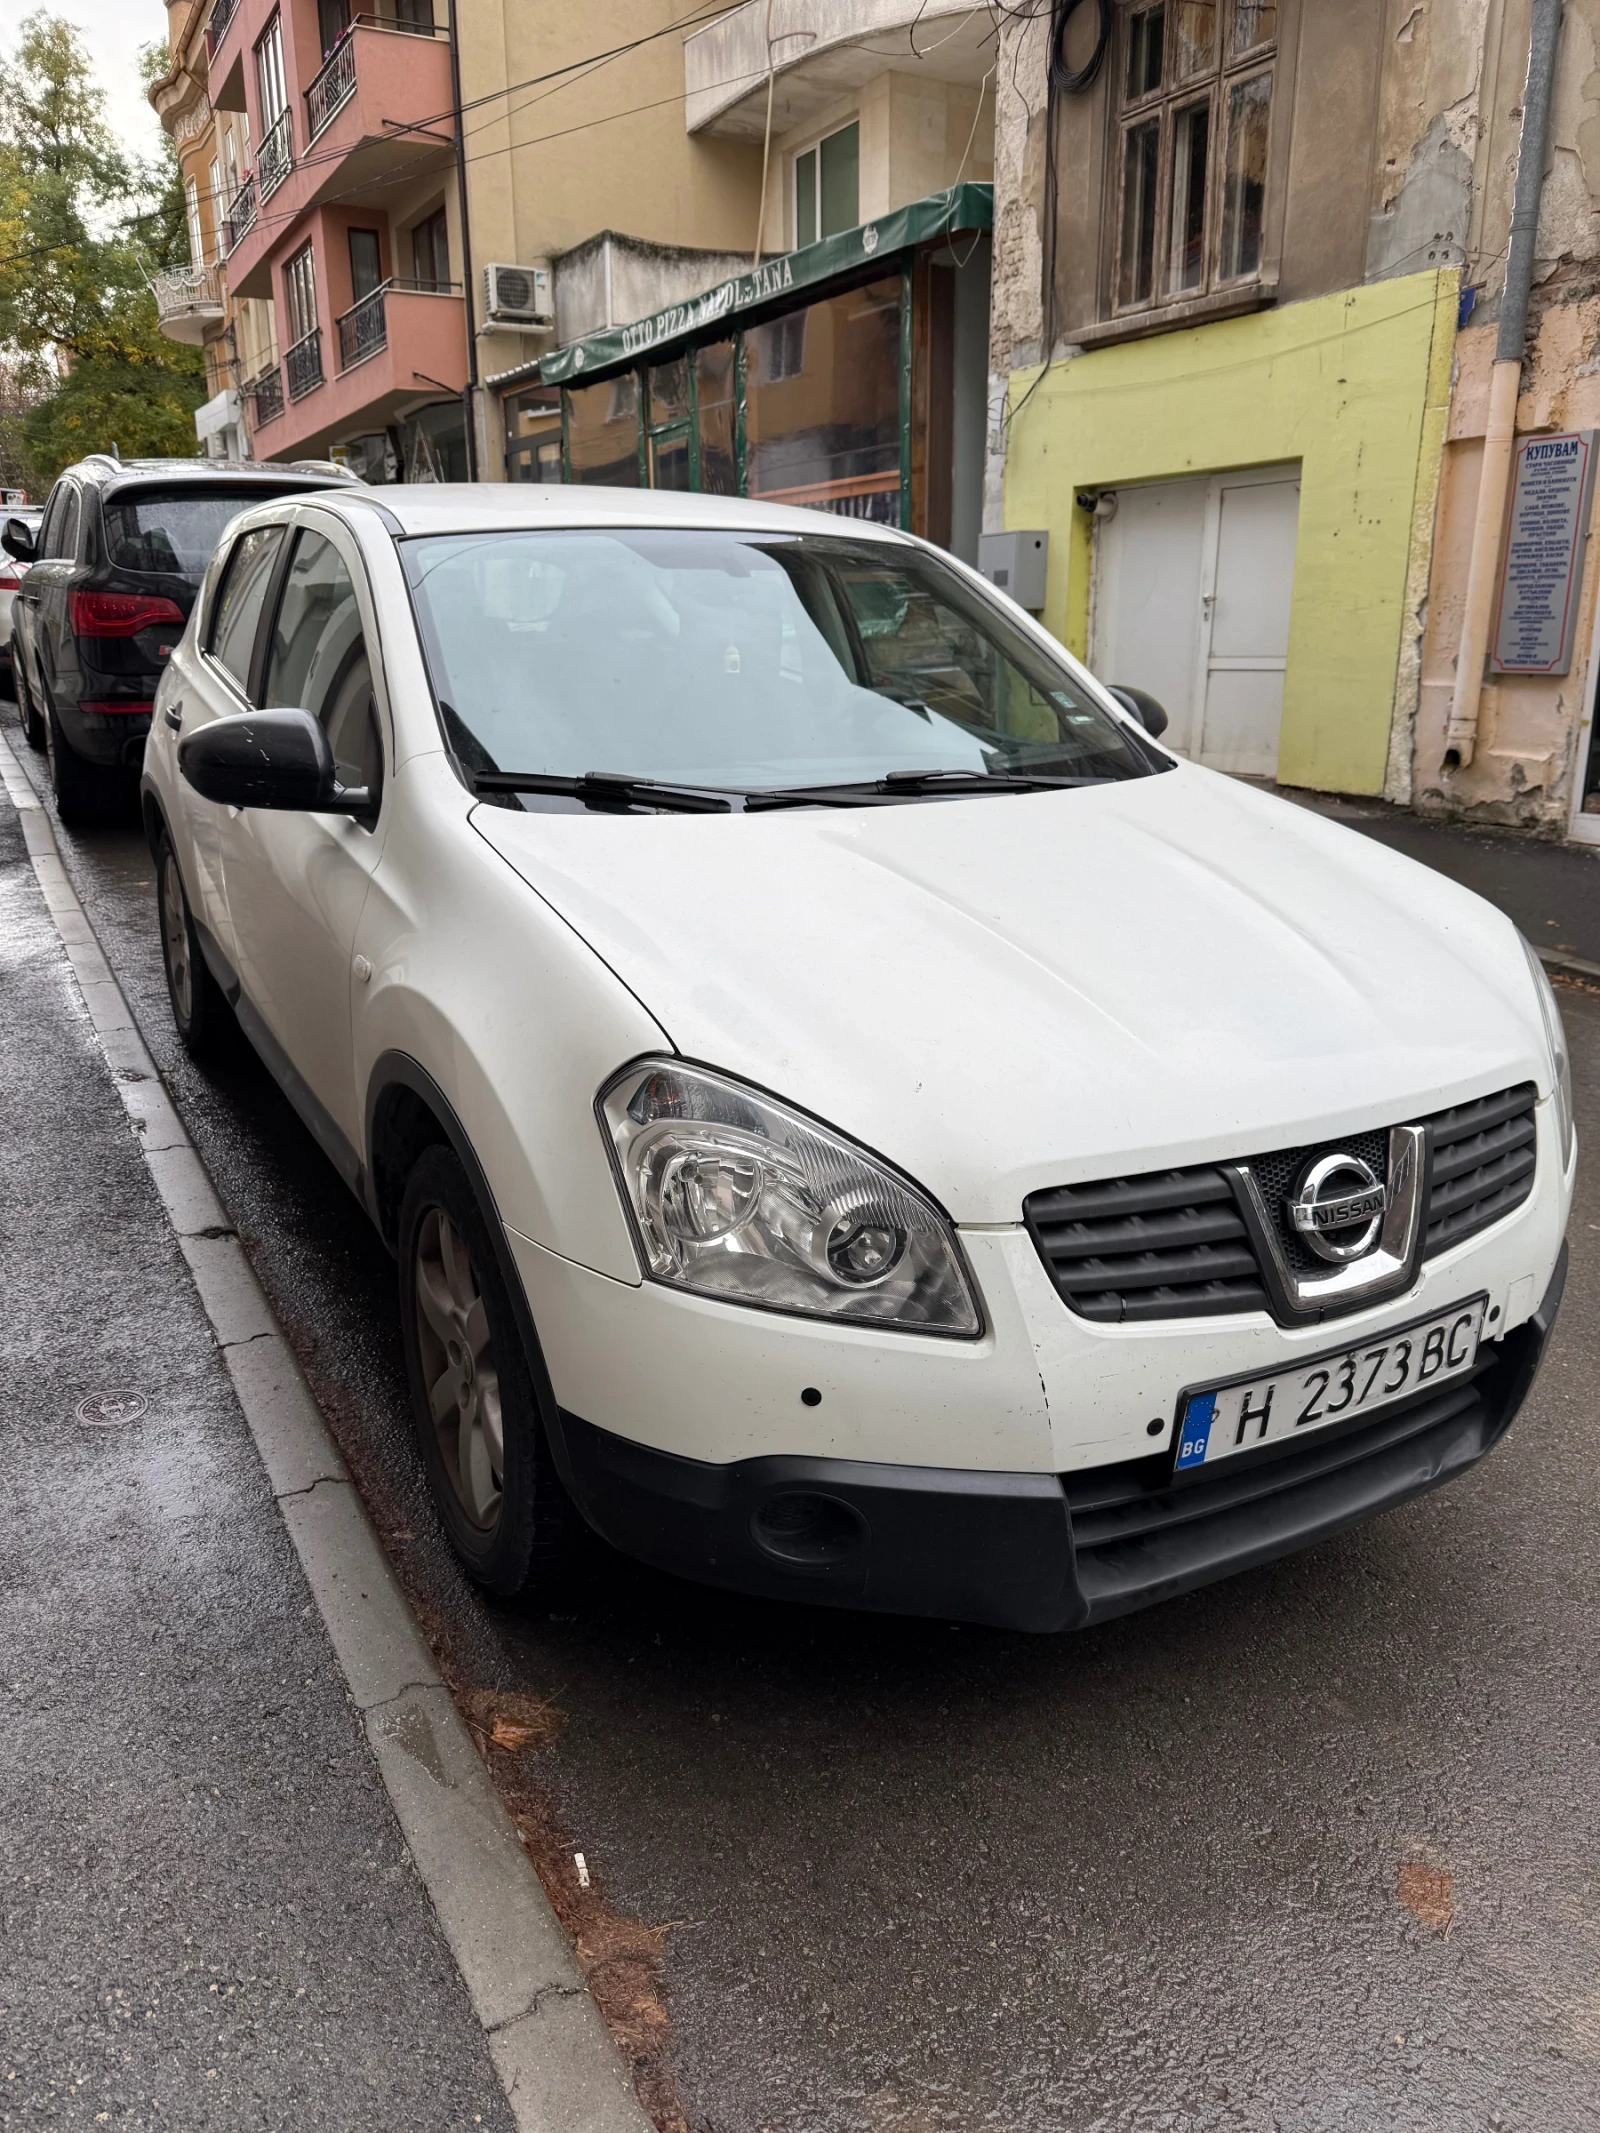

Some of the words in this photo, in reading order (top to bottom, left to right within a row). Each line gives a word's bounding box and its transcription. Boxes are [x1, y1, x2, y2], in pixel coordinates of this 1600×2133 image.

[622, 319, 653, 353] OTTO
[656, 304, 694, 338] PIZZA
[1526, 441, 1578, 460] КУПУВАМ
[1311, 1194, 1384, 1227] NISSAN
[1234, 1383, 1275, 1445] H
[1296, 1338, 1412, 1427] 2373
[1418, 1313, 1473, 1383] BC
[1182, 1438, 1205, 1458] BG
